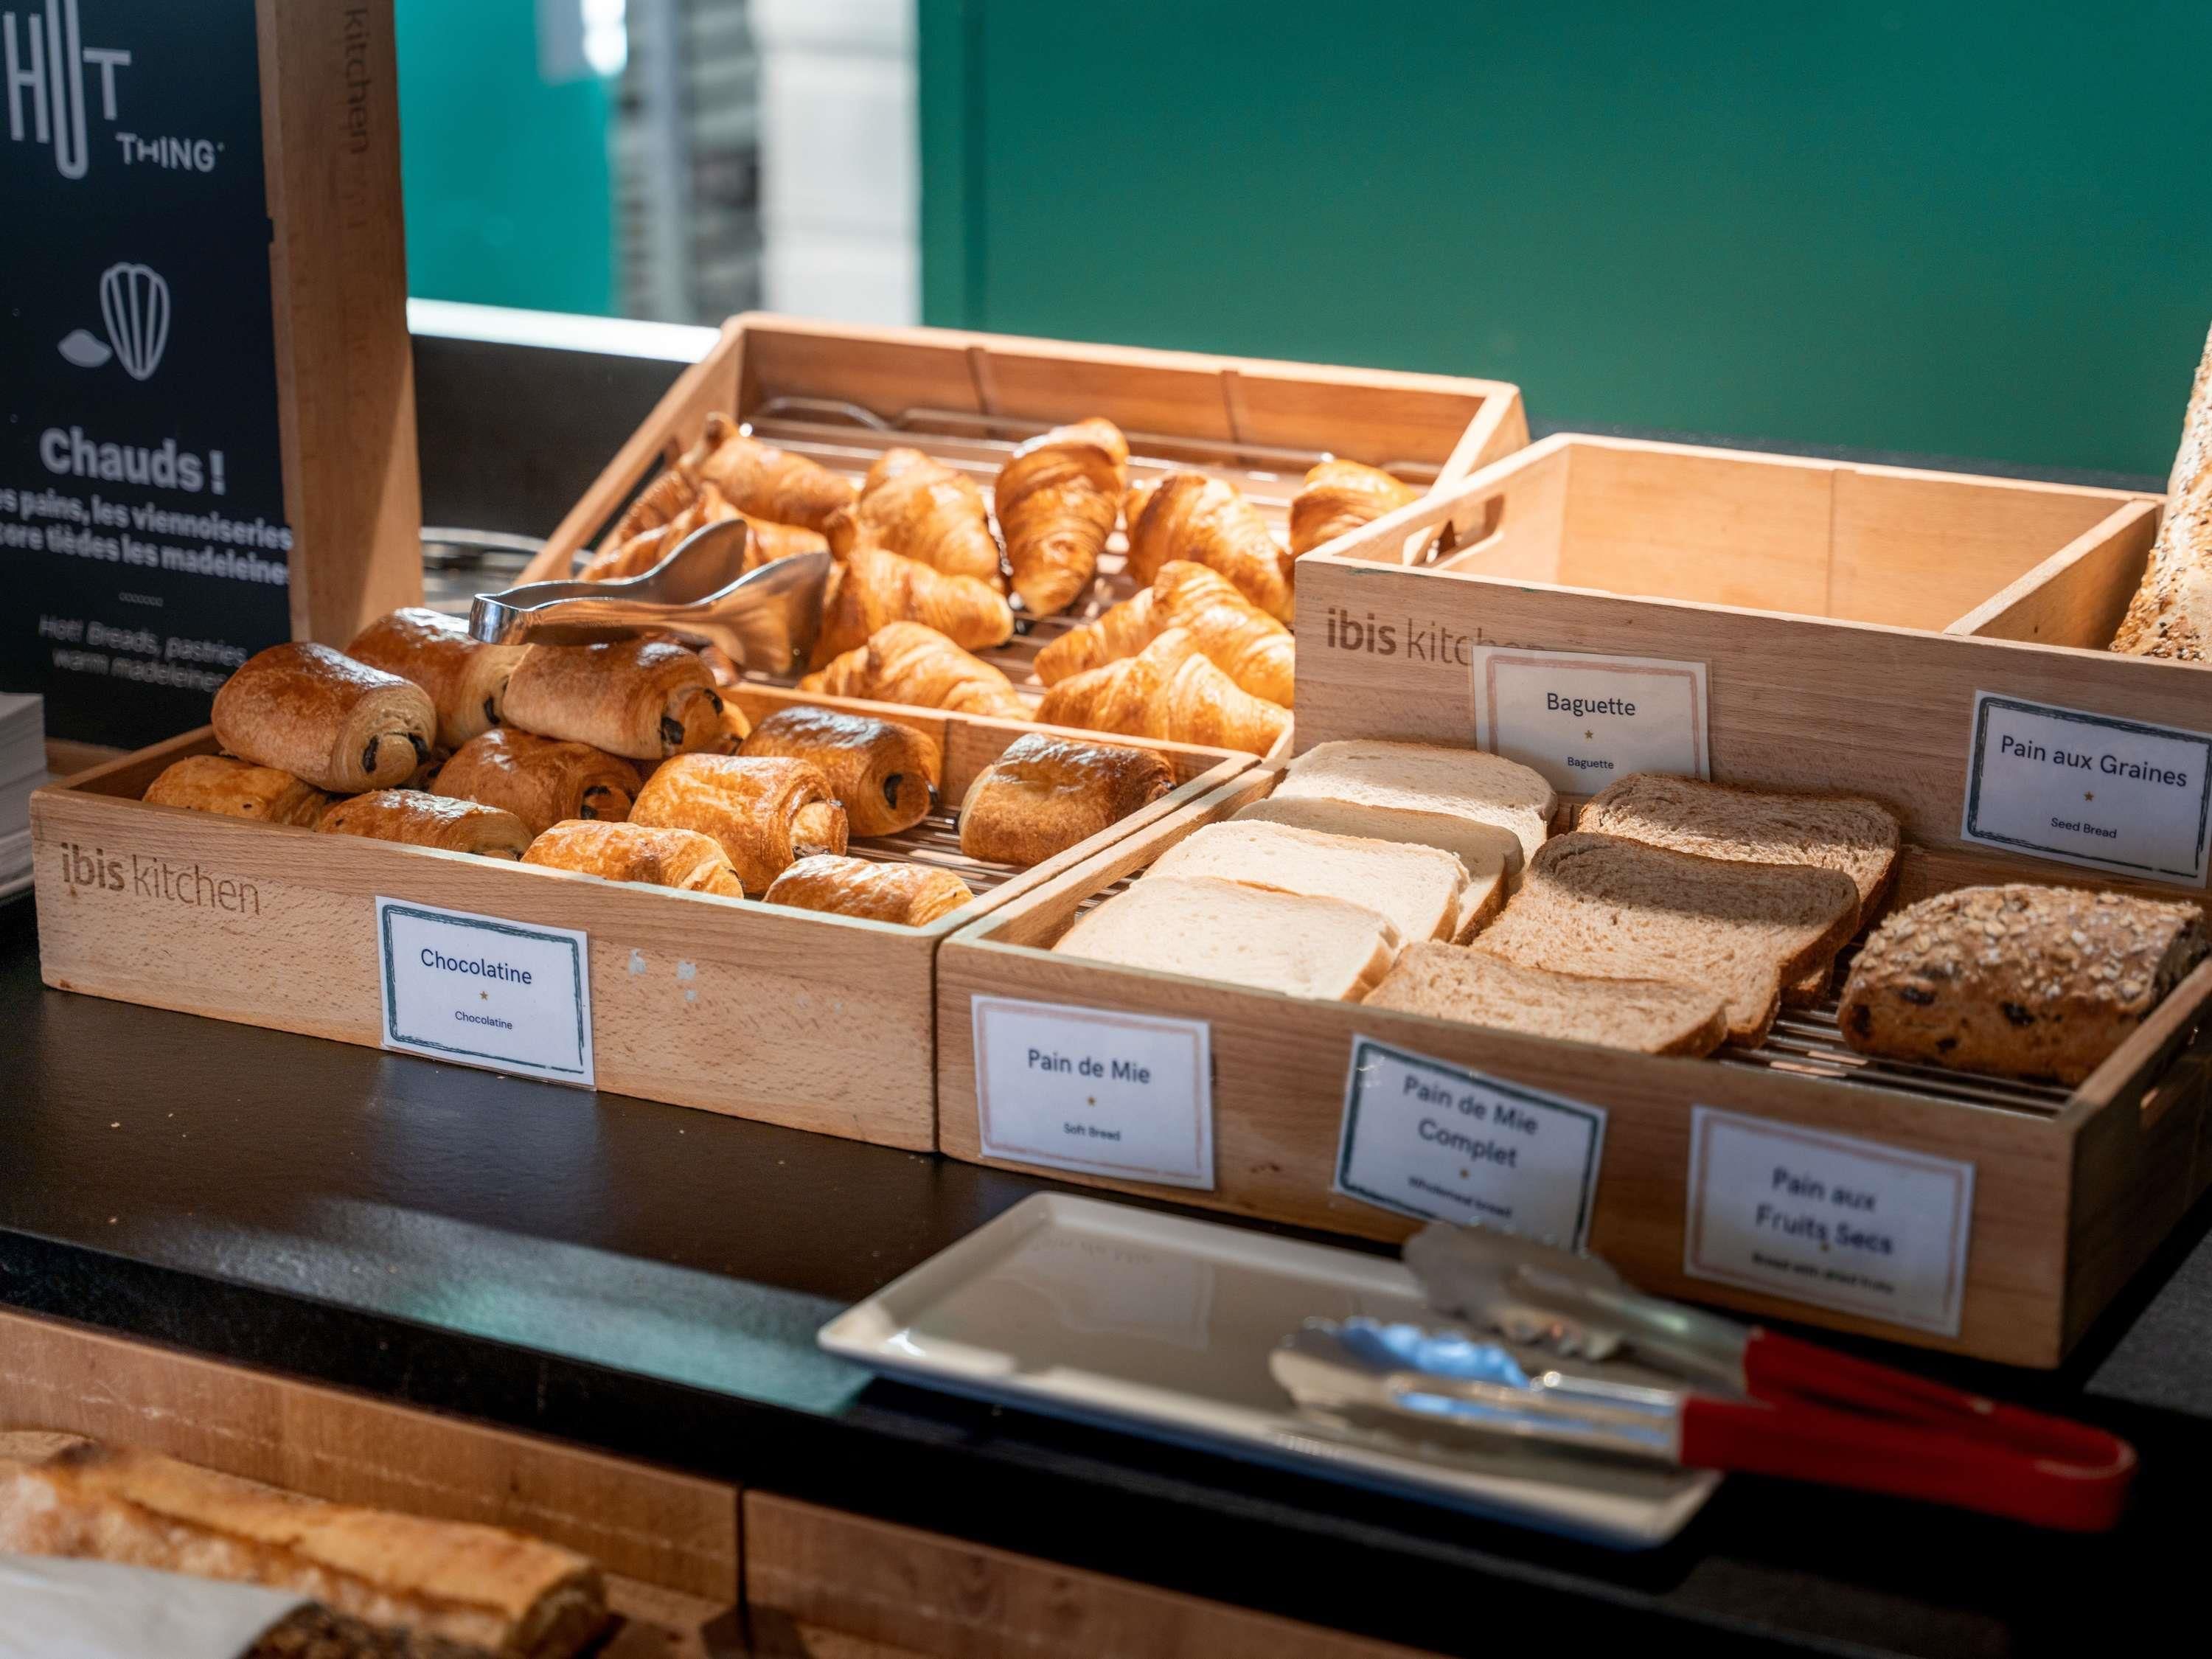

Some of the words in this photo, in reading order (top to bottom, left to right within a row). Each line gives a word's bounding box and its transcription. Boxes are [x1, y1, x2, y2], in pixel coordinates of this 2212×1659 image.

[344, 8, 372, 154] kitchen
[39, 425, 204, 493] Chauds
[91, 494, 131, 528] les
[131, 501, 293, 550] viennoiseries
[120, 533, 159, 568] les
[160, 545, 289, 585] madeleine
[1327, 608, 1397, 655] ibis
[1546, 692, 1636, 717] Baguette
[1567, 757, 1615, 771] Baguette
[2001, 734, 2045, 762] Pain
[2053, 749, 2092, 771] aux
[2100, 754, 2188, 787] Graines
[2051, 818, 2080, 833] Seed
[2084, 824, 2118, 838] Bread
[60, 842, 126, 892] ibis
[133, 855, 261, 916] kitchen
[420, 947, 532, 985] Chocolatine
[454, 1010, 513, 1031] Chocolatine
[1027, 1048, 1072, 1074] Pain
[1078, 1057, 1104, 1078] de
[1111, 1060, 1151, 1084] Mie
[1402, 1074, 1453, 1107] Pain
[1458, 1095, 1487, 1120] de
[1492, 1104, 1539, 1135] Mie
[1064, 1122, 1085, 1136] Soft
[1088, 1126, 1121, 1141] Bread
[1417, 1116, 1518, 1169] Complet
[1771, 1164, 1825, 1201] Pain
[1831, 1186, 1876, 1213] aux
[1755, 1203, 1828, 1242] Fruits
[1834, 1222, 1893, 1256] Secs
